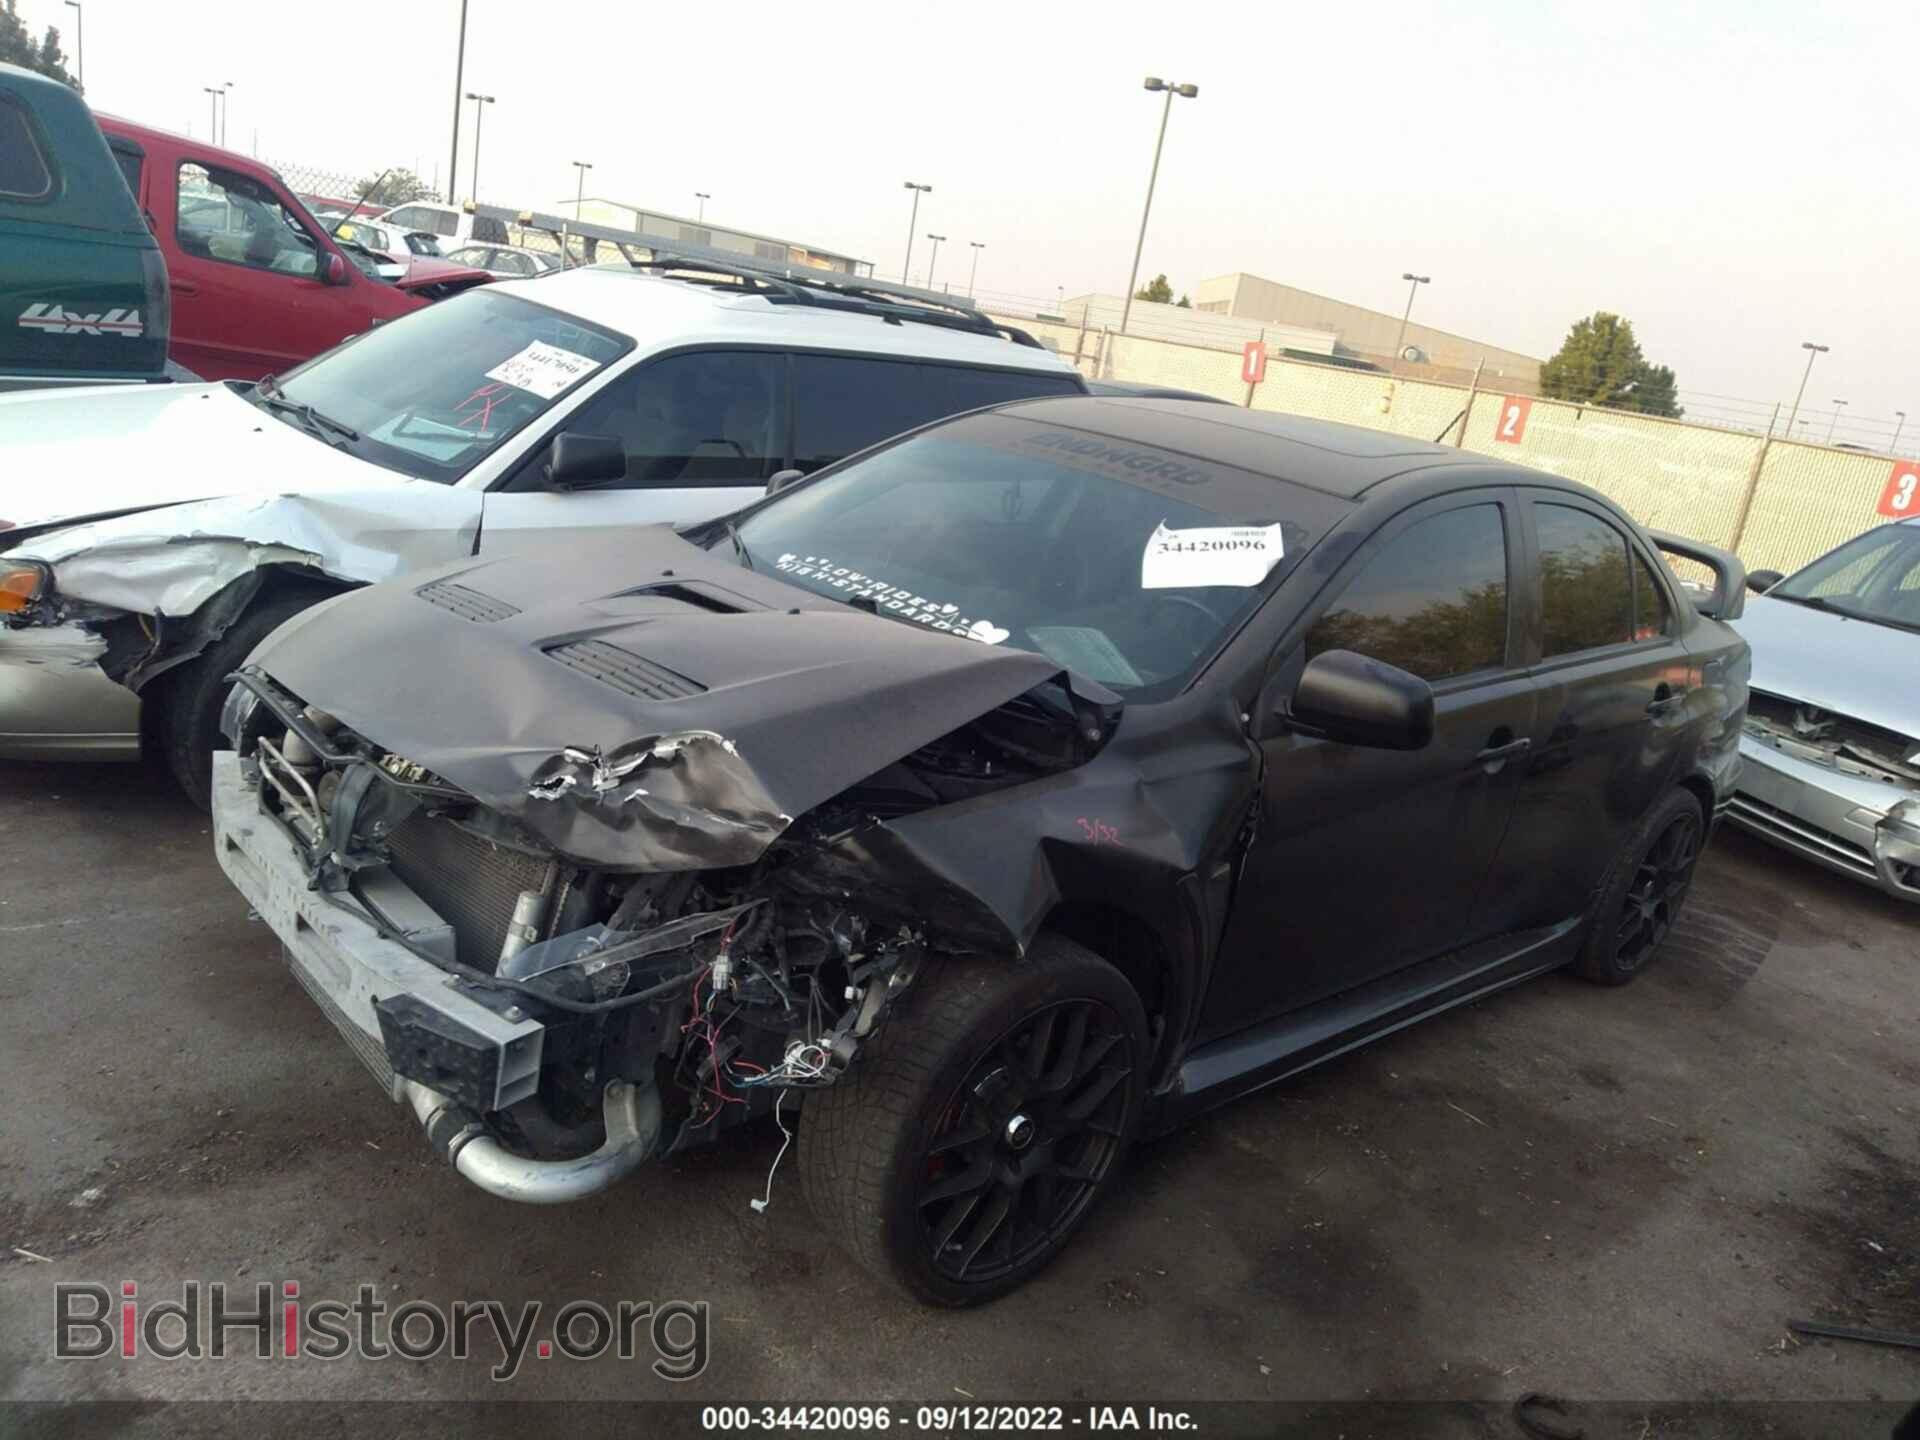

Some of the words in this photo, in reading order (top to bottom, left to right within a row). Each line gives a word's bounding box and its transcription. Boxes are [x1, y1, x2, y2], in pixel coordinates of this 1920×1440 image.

[17, 302, 144, 338] 4x4
[1248, 349, 1258, 376] 1
[1502, 404, 1520, 436] 2
[1892, 473, 1918, 511] 3
[1157, 540, 1267, 554] 34420096
